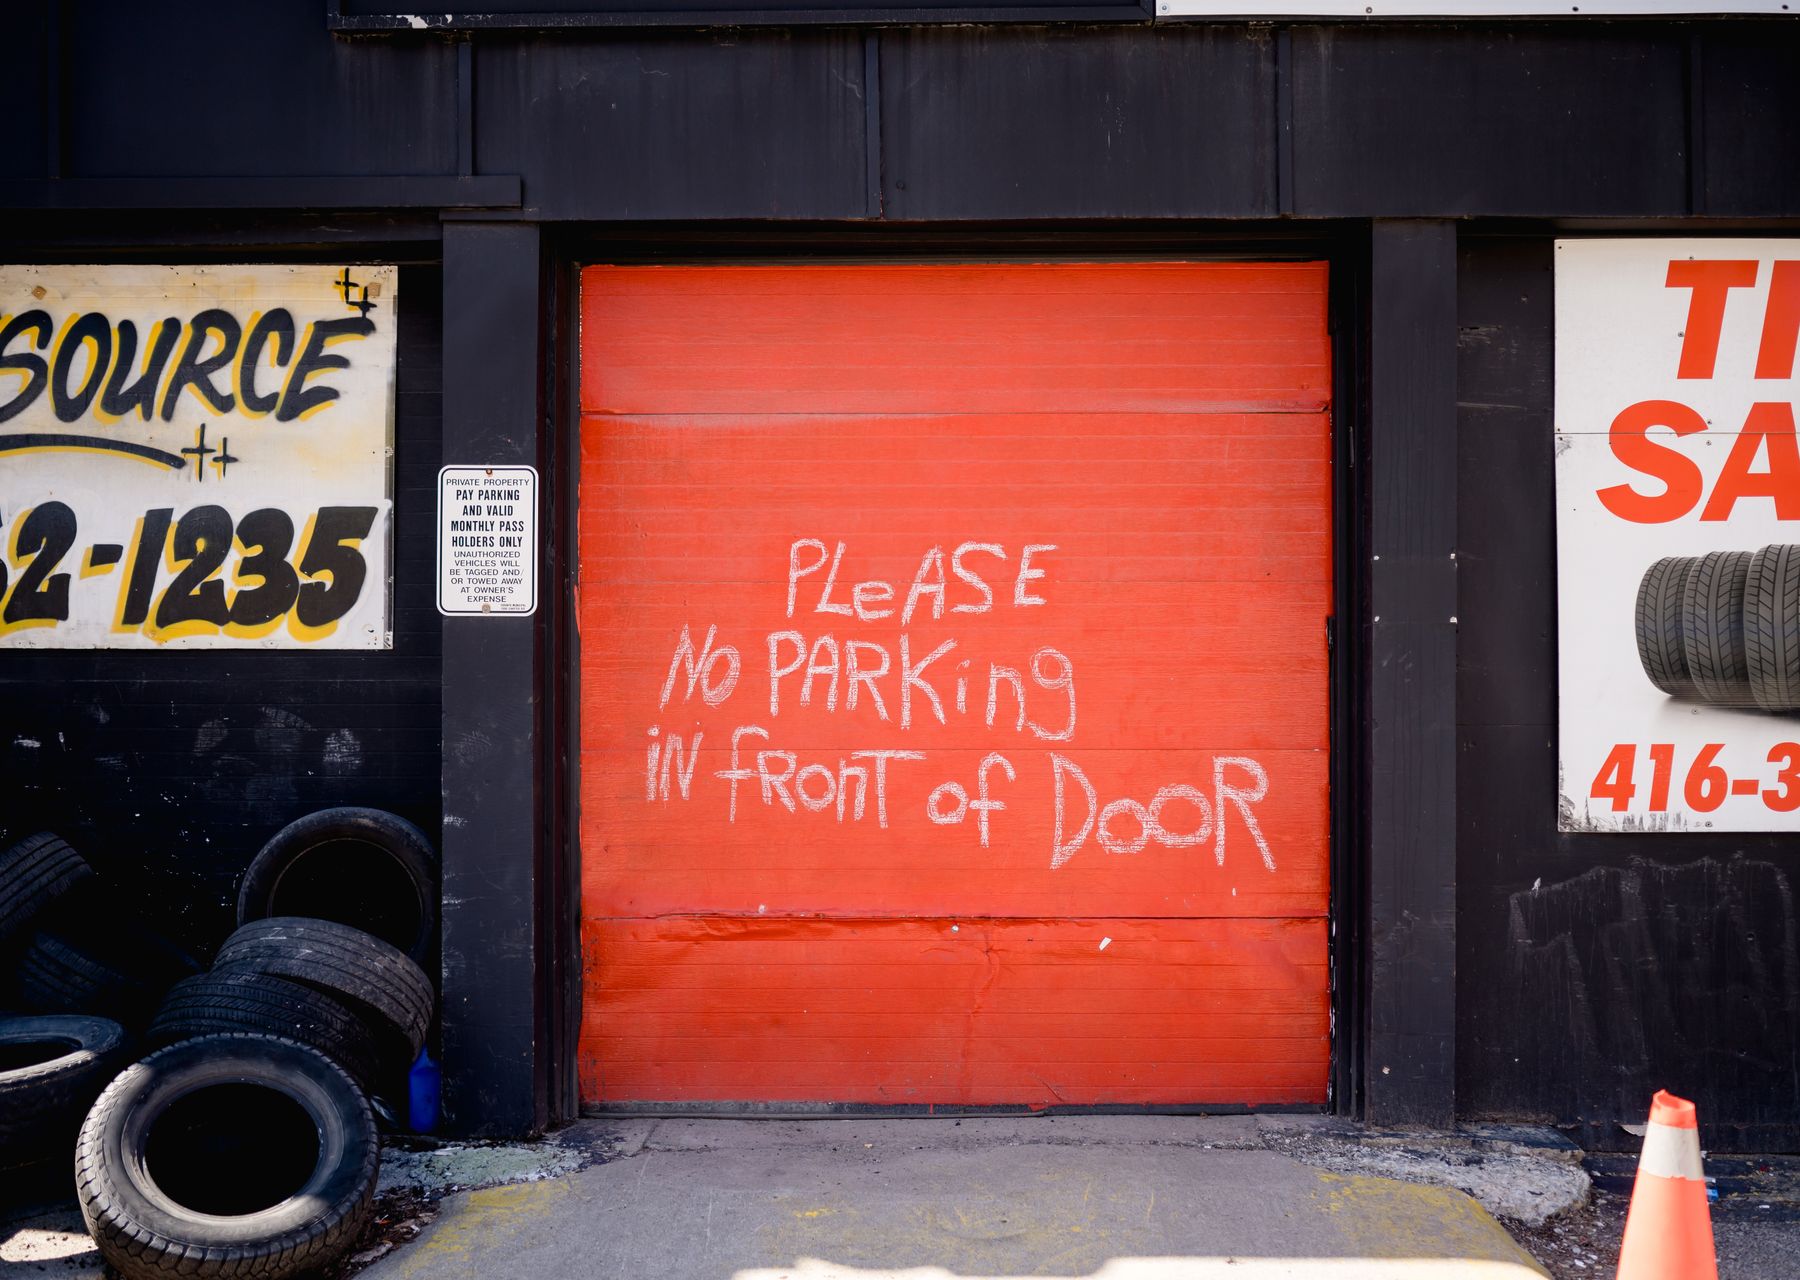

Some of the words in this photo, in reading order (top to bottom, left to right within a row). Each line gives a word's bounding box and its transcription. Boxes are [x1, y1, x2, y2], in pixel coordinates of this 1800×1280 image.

[0, 308, 375, 423] SOURCE
[1597, 400, 1800, 524] SA
[456, 490, 473, 500] PAY
[478, 490, 519, 500] PARKING
[463, 505, 482, 516] AND
[487, 505, 513, 516] VALID
[451, 520, 495, 531] MONTHLY
[500, 521, 524, 532] PASS
[452, 536, 494, 547] HOLDERS
[499, 536, 522, 547] ONLY
[0, 501, 378, 636] 2-1235
[927, 752, 1016, 847] of
